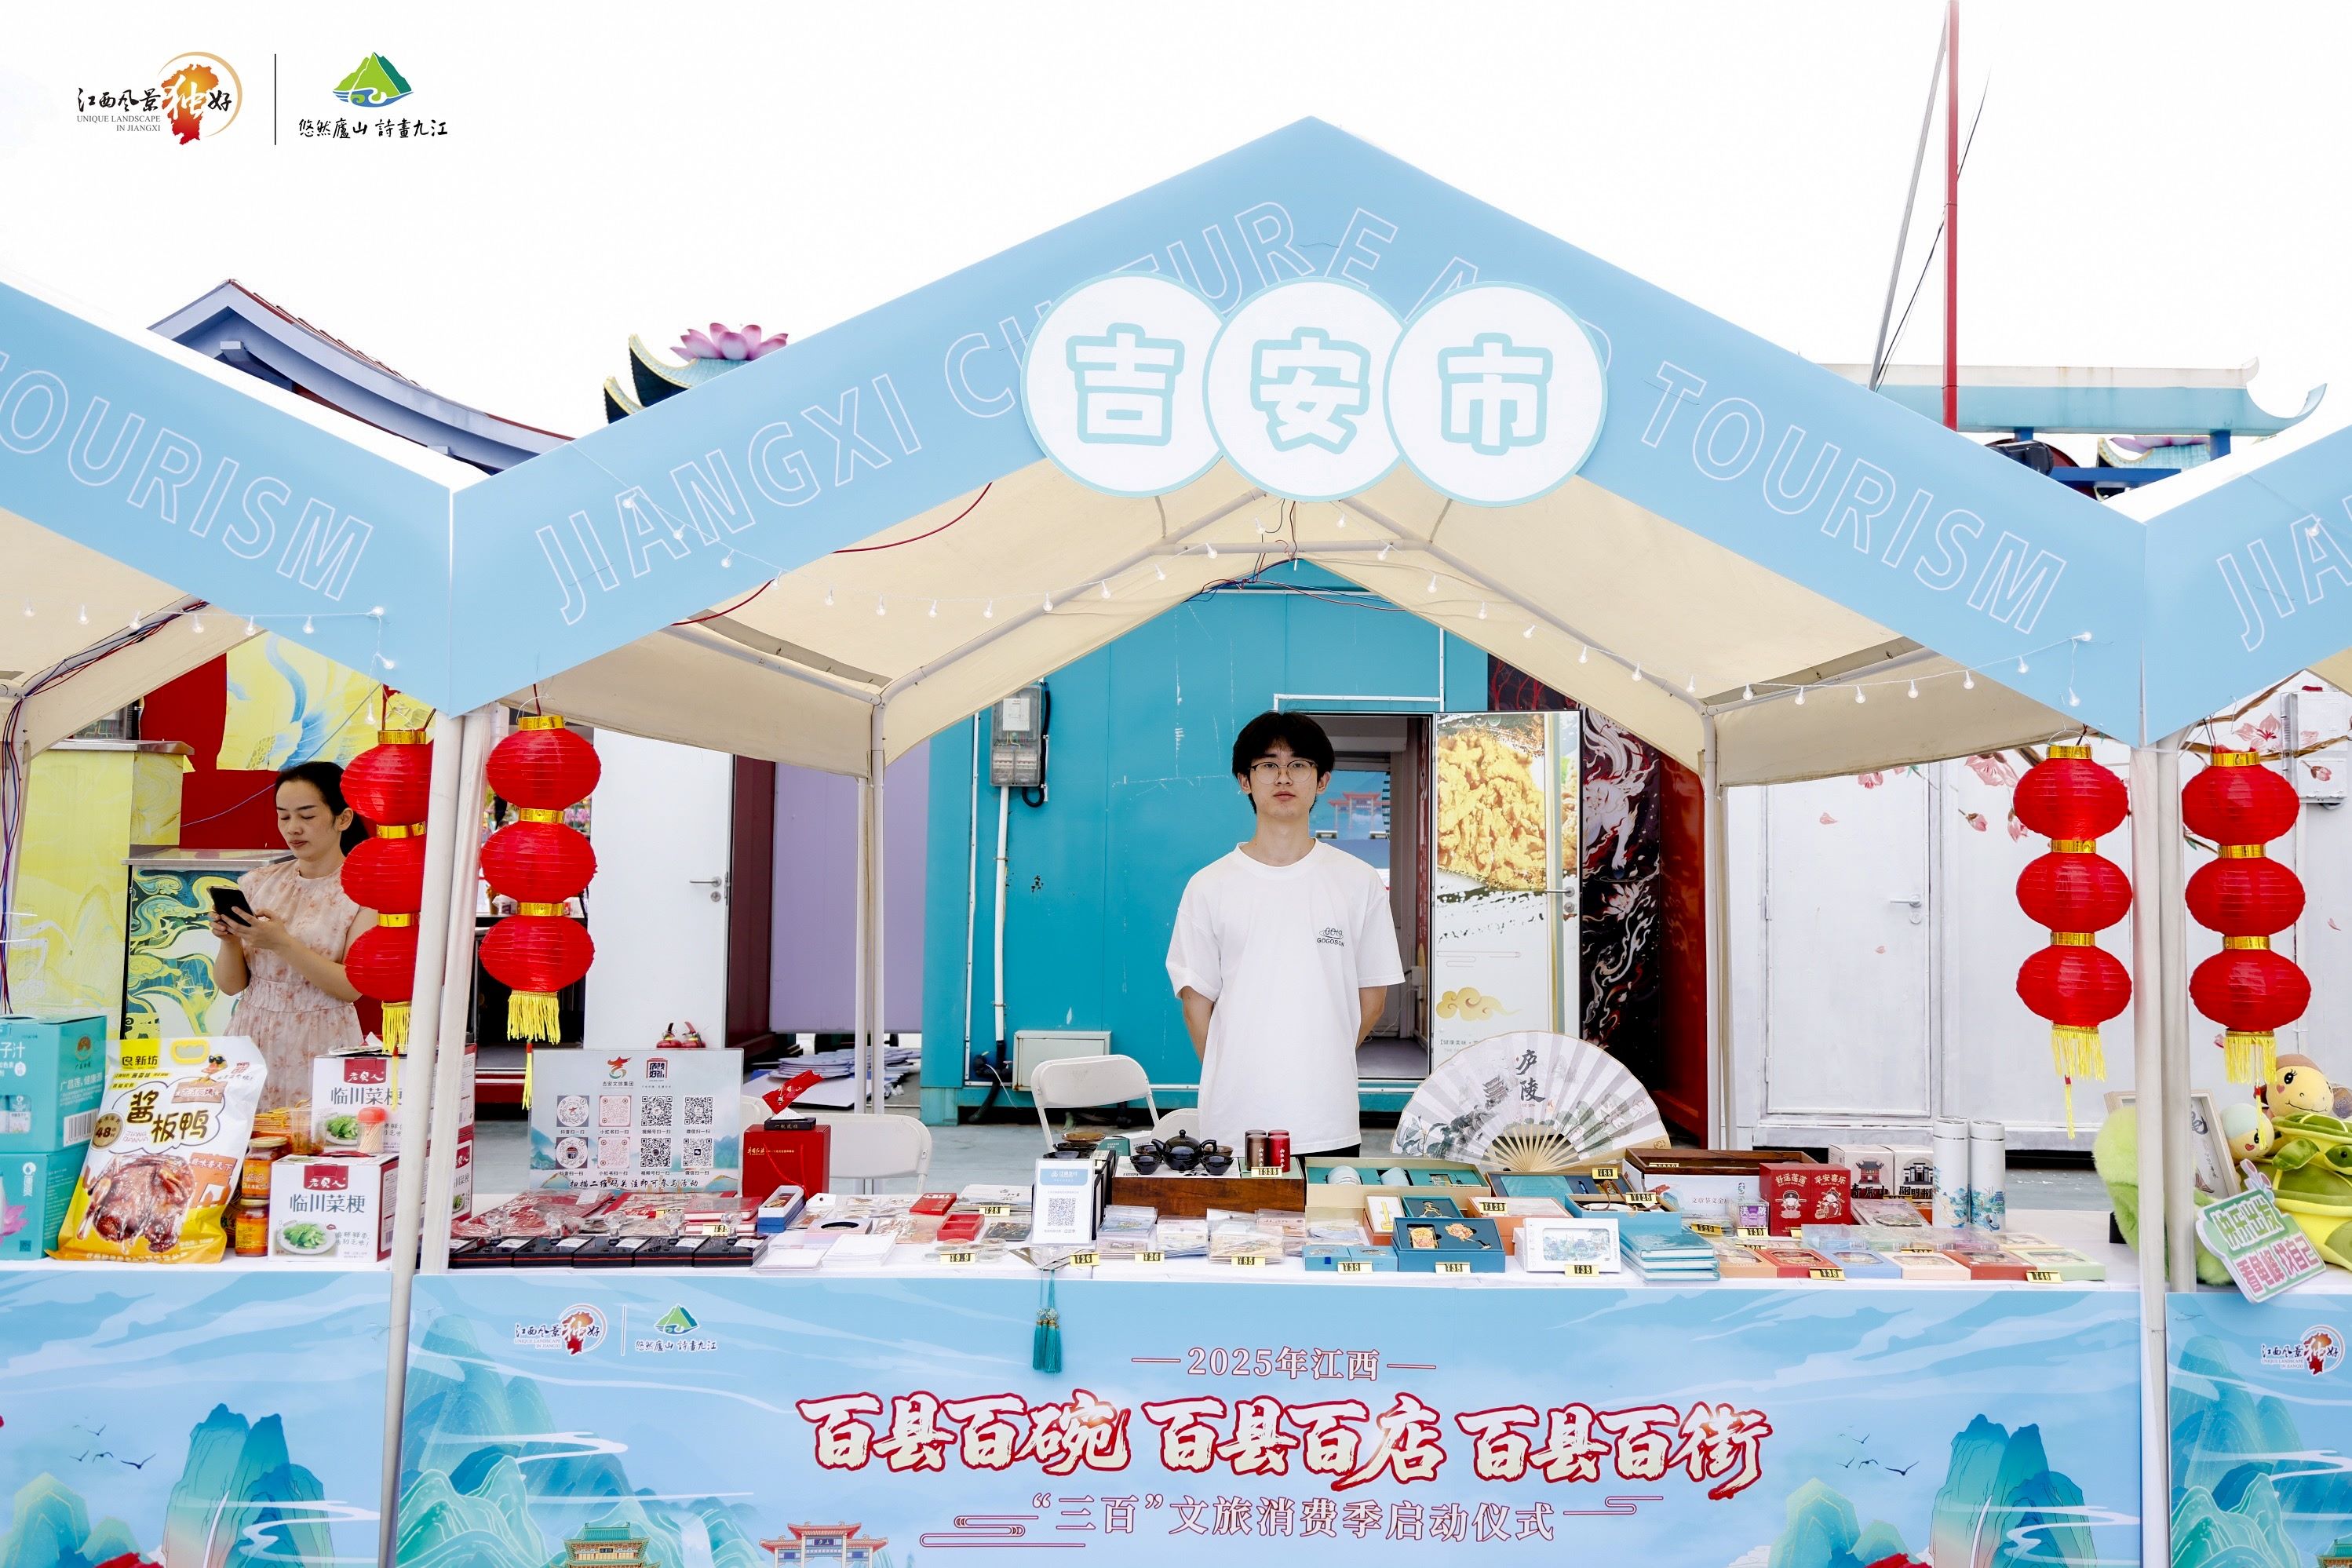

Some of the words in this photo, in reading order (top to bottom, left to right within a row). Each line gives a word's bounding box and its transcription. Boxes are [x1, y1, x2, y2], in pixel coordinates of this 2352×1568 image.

[1066, 323, 1553, 455] 吉安市
[0, 352, 373, 600] OURISM
[535, 374, 921, 625] JIANGXI
[1641, 360, 2066, 634] TOURISM
[2216, 494, 2352, 651] JIA
[1515, 1049, 1545, 1102] 庐陵
[127, 1090, 209, 1143] 酱板鸭
[95, 1127, 111, 1138] 48
[570, 1179, 698, 1188] 扫描二维码关注即可参与活动
[1814, 1174, 1847, 1184] 平安喜乐
[290, 1194, 366, 1213] 临川菜梗
[1483, 1202, 1507, 1212] ¥128
[950, 1253, 970, 1262] ¥9.9
[1075, 1255, 1092, 1264] ¥26
[1144, 1253, 1160, 1261] ¥26
[1238, 1256, 1254, 1265] ¥85
[1344, 1262, 1360, 1271] ¥38
[1445, 1263, 1462, 1272] ¥38
[1574, 1264, 1592, 1274] ¥38
[1821, 1269, 1838, 1278] ¥38
[516, 1318, 600, 1341] 江西风景独好
[1187, 1346, 1380, 1380] 2025年江西
[795, 1389, 1130, 1475] 百县百碗
[1141, 1391, 1446, 1491] 百县百店
[1454, 1401, 1773, 1500] 百县百街
[1032, 1493, 1555, 1543] “三百”文旅消费季启动仪式
